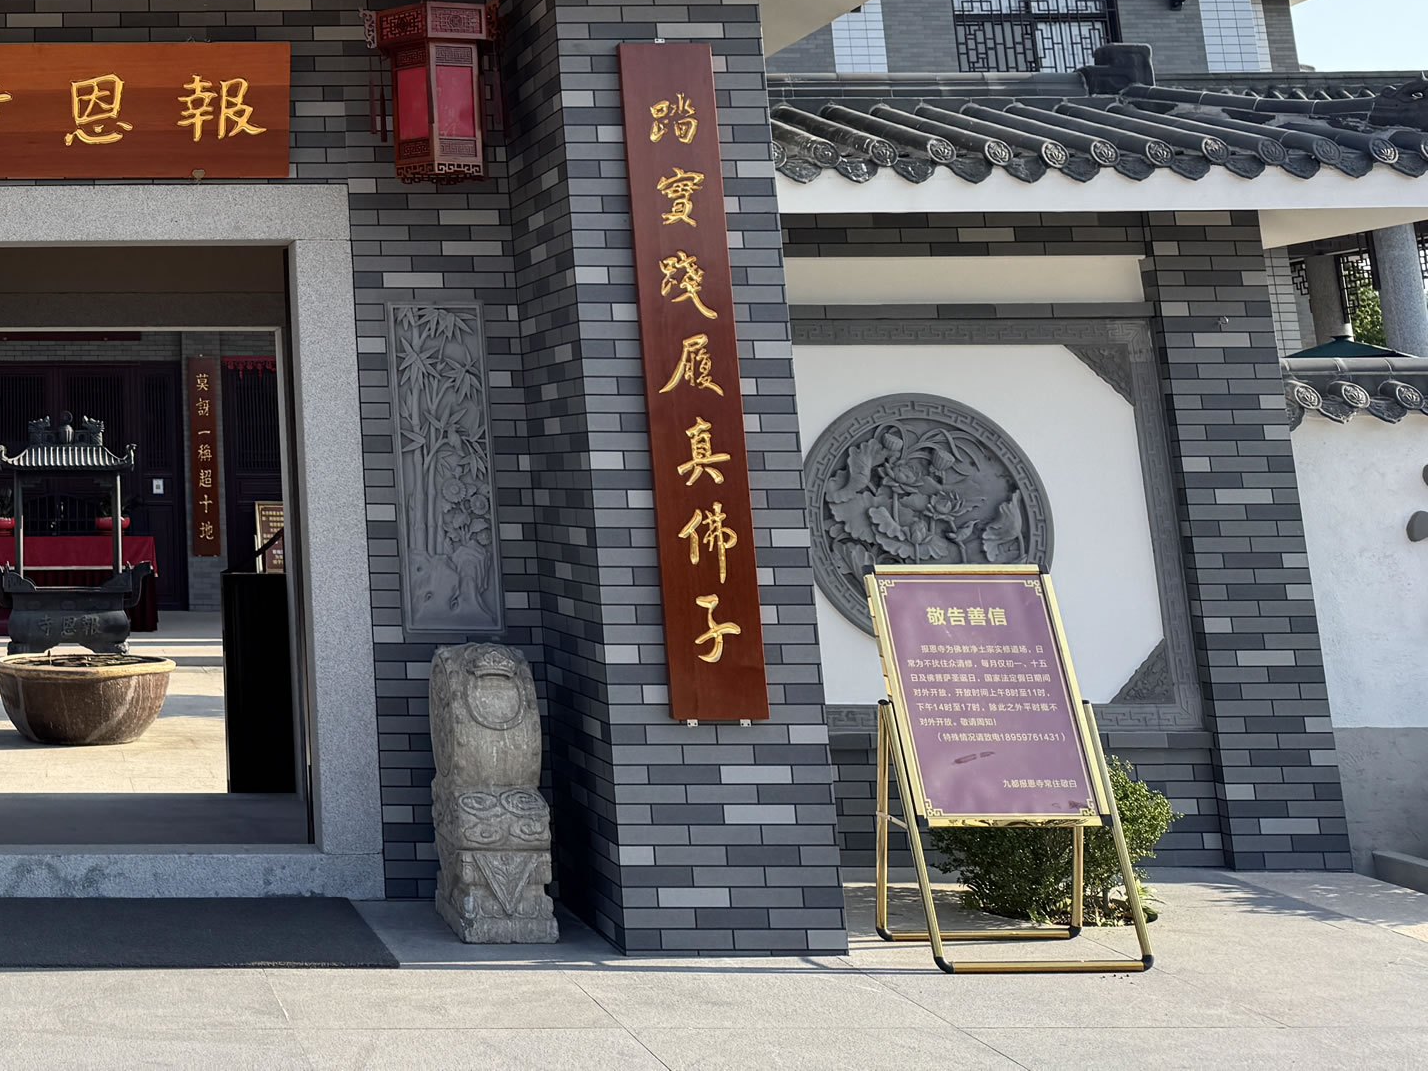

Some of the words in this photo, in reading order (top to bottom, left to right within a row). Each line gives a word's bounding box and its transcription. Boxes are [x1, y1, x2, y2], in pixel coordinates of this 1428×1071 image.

[649, 92, 741, 663] 踏實踐履真佛子
[926, 607, 1007, 626] 敬告善信
